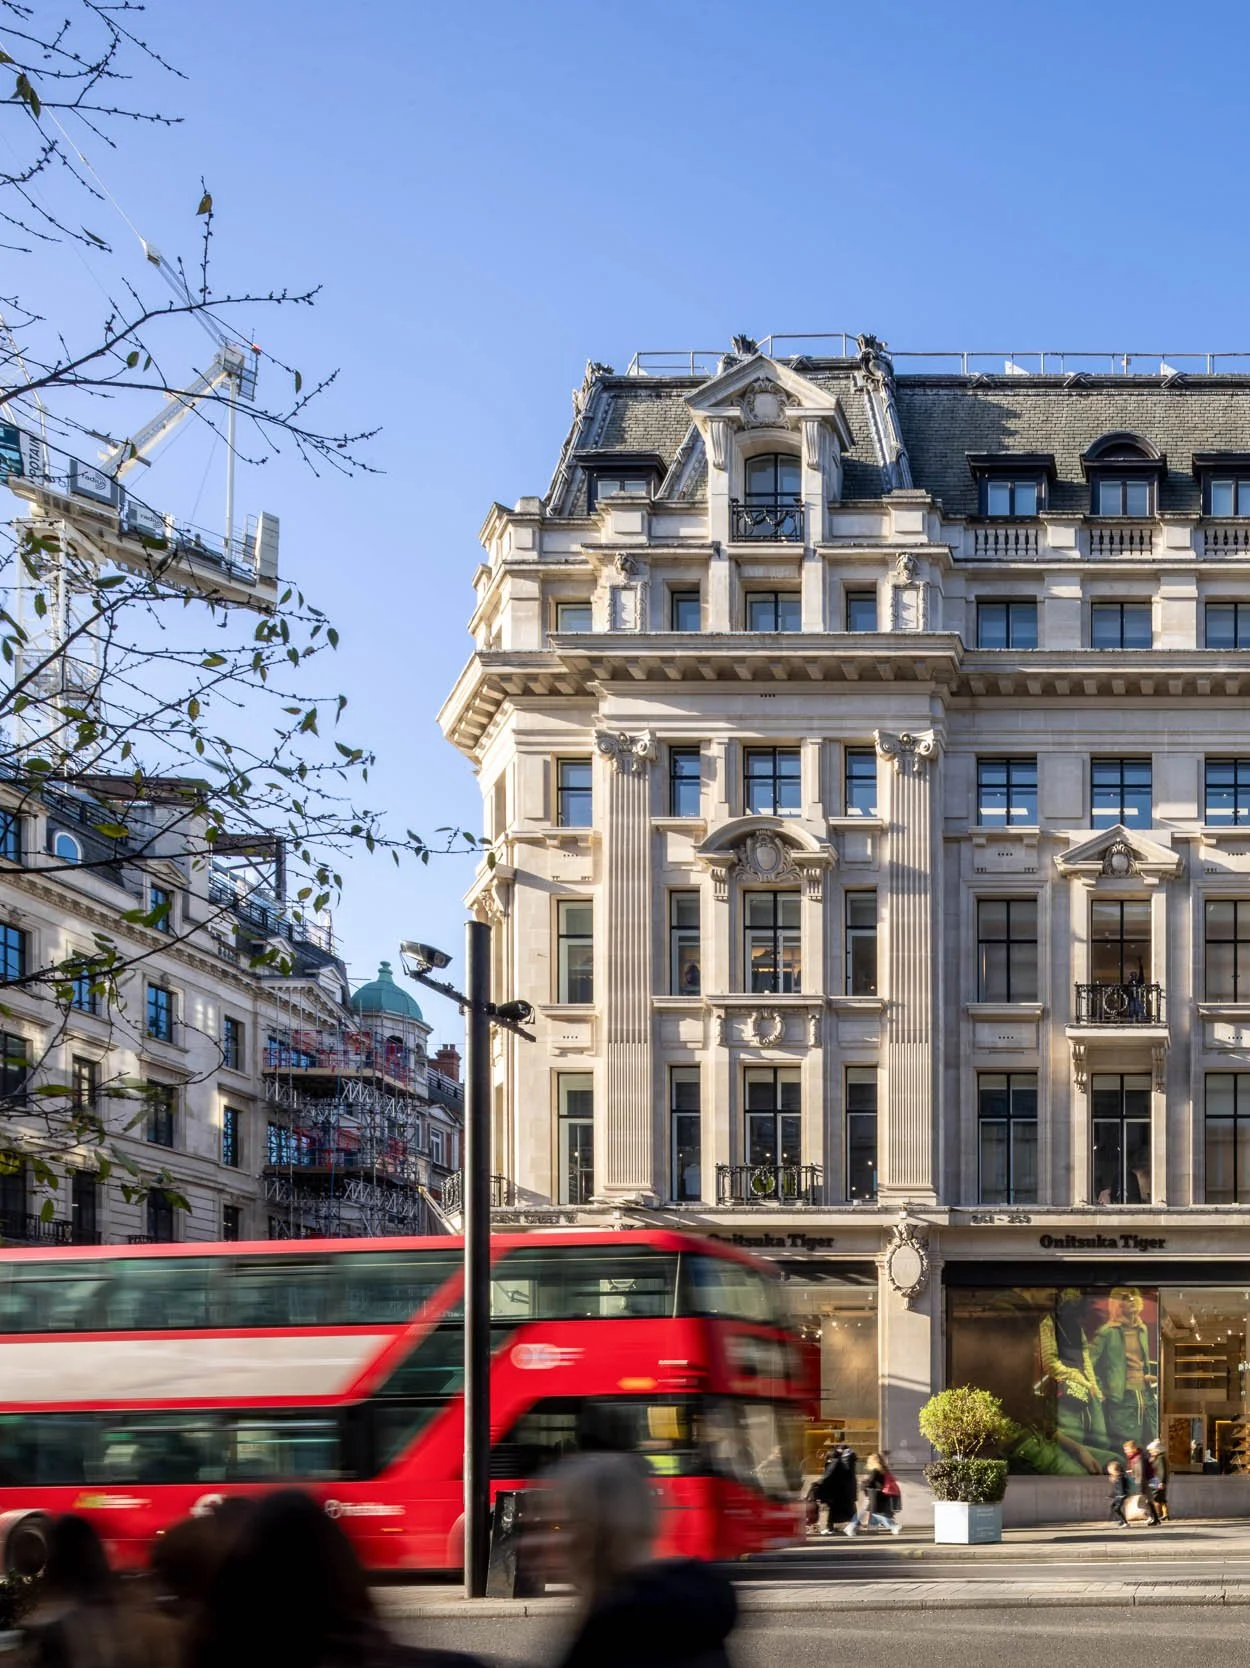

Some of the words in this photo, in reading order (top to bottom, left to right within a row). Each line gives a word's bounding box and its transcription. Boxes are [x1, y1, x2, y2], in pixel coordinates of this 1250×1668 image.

[787, 1233, 834, 1251] Tiger
[1039, 1234, 1118, 1248] Onitsuka
[1119, 1234, 1166, 1251] Tiger
